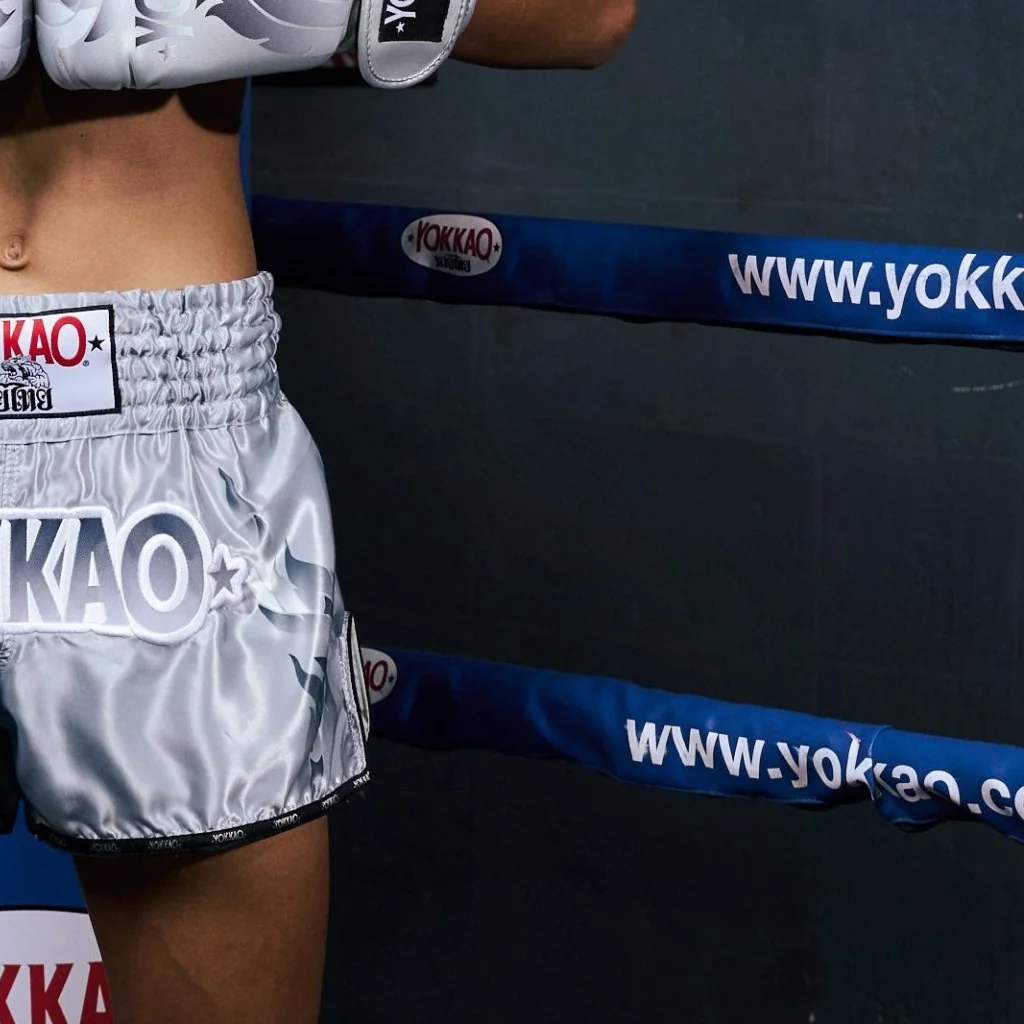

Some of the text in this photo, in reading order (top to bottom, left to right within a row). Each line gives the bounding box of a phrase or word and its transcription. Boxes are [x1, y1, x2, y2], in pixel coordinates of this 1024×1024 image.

[416, 220, 493, 261] YOKKAO
[728, 253, 1024, 320] www.yokk
[212, 829, 244, 844] YOKKAO
